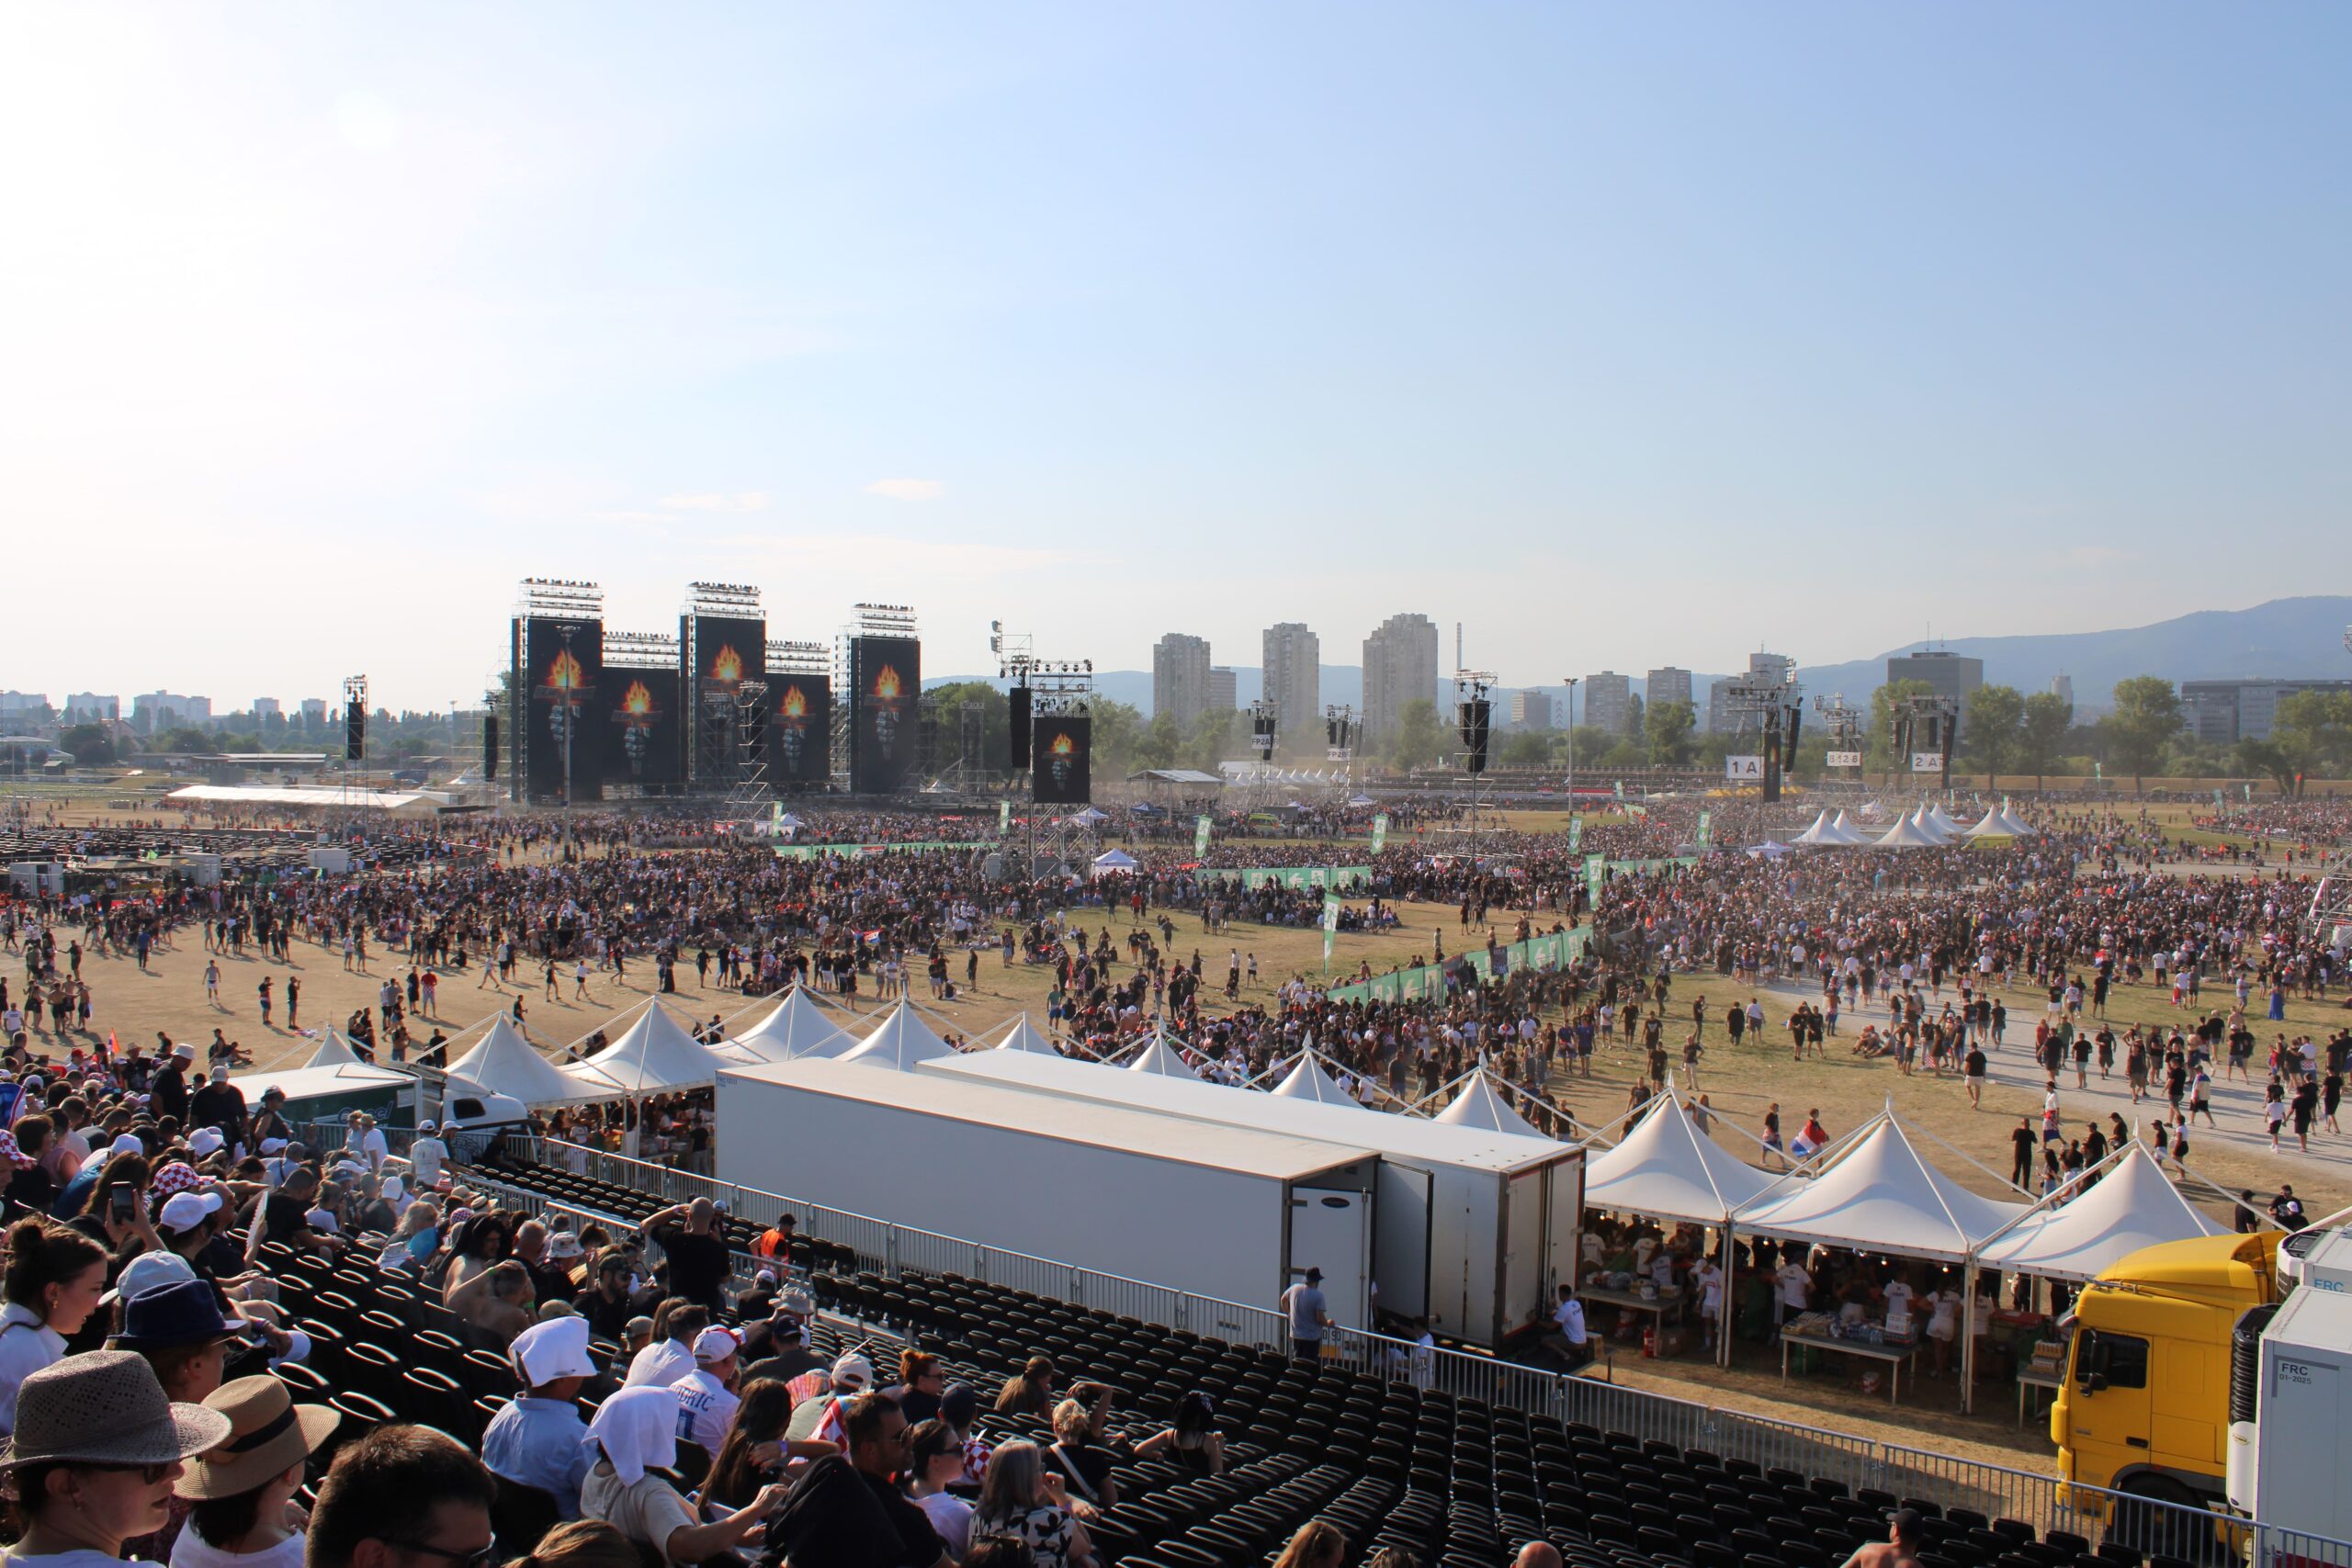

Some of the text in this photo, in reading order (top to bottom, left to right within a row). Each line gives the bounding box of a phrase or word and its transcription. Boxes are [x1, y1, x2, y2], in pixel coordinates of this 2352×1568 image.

[1733, 761, 1758, 773] 1 A
[1916, 757, 1938, 767] 2 A
[2314, 1278, 2345, 1292] FRC
[2281, 1363, 2308, 1375] FRC
[2279, 1373, 2312, 1384] 01-2025
